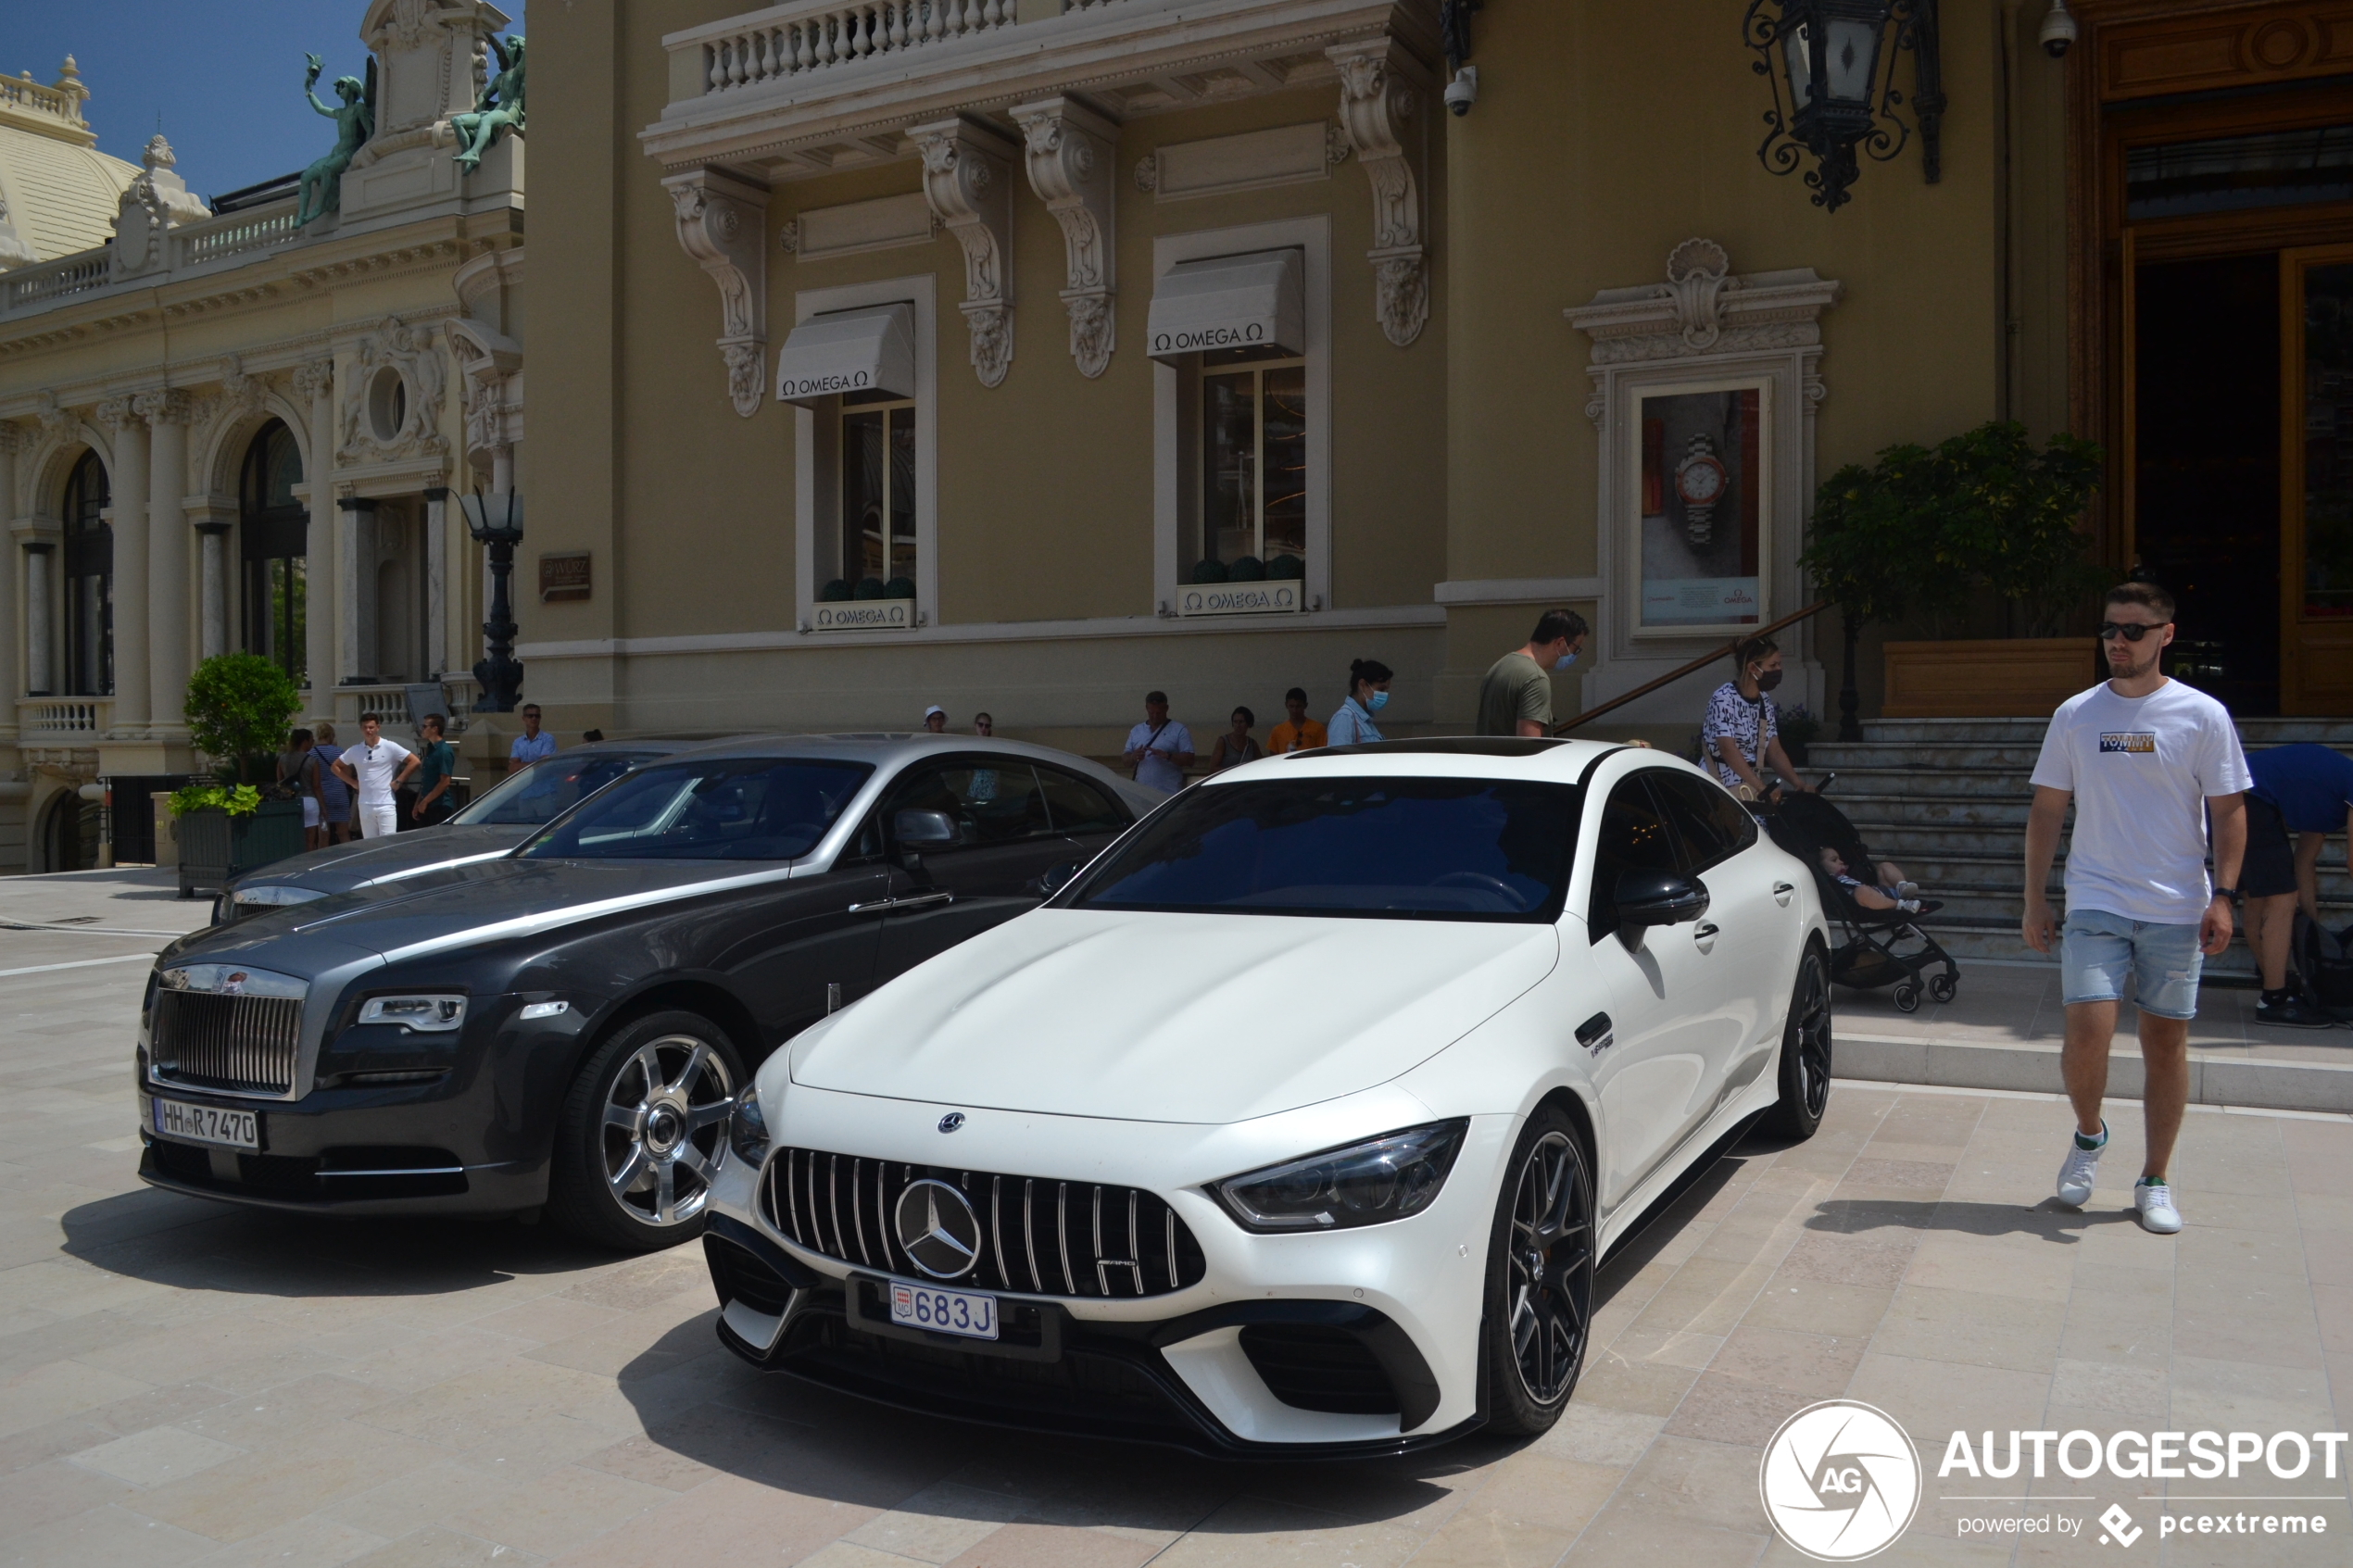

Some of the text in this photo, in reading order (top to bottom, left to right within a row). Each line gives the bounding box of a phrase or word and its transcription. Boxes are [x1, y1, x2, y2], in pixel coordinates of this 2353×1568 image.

[1176, 328, 1241, 348] OMEGA
[799, 375, 850, 394] OMEGA
[1208, 592, 1270, 608] OMEGA
[1724, 596, 1753, 605] OMEGA
[836, 609, 887, 625] OMEGA
[2102, 735, 2153, 747] TOMMY
[163, 1103, 184, 1133] HH
[208, 1110, 255, 1143] 7470
[898, 1302, 909, 1313] MC
[915, 1291, 990, 1332] 683J
